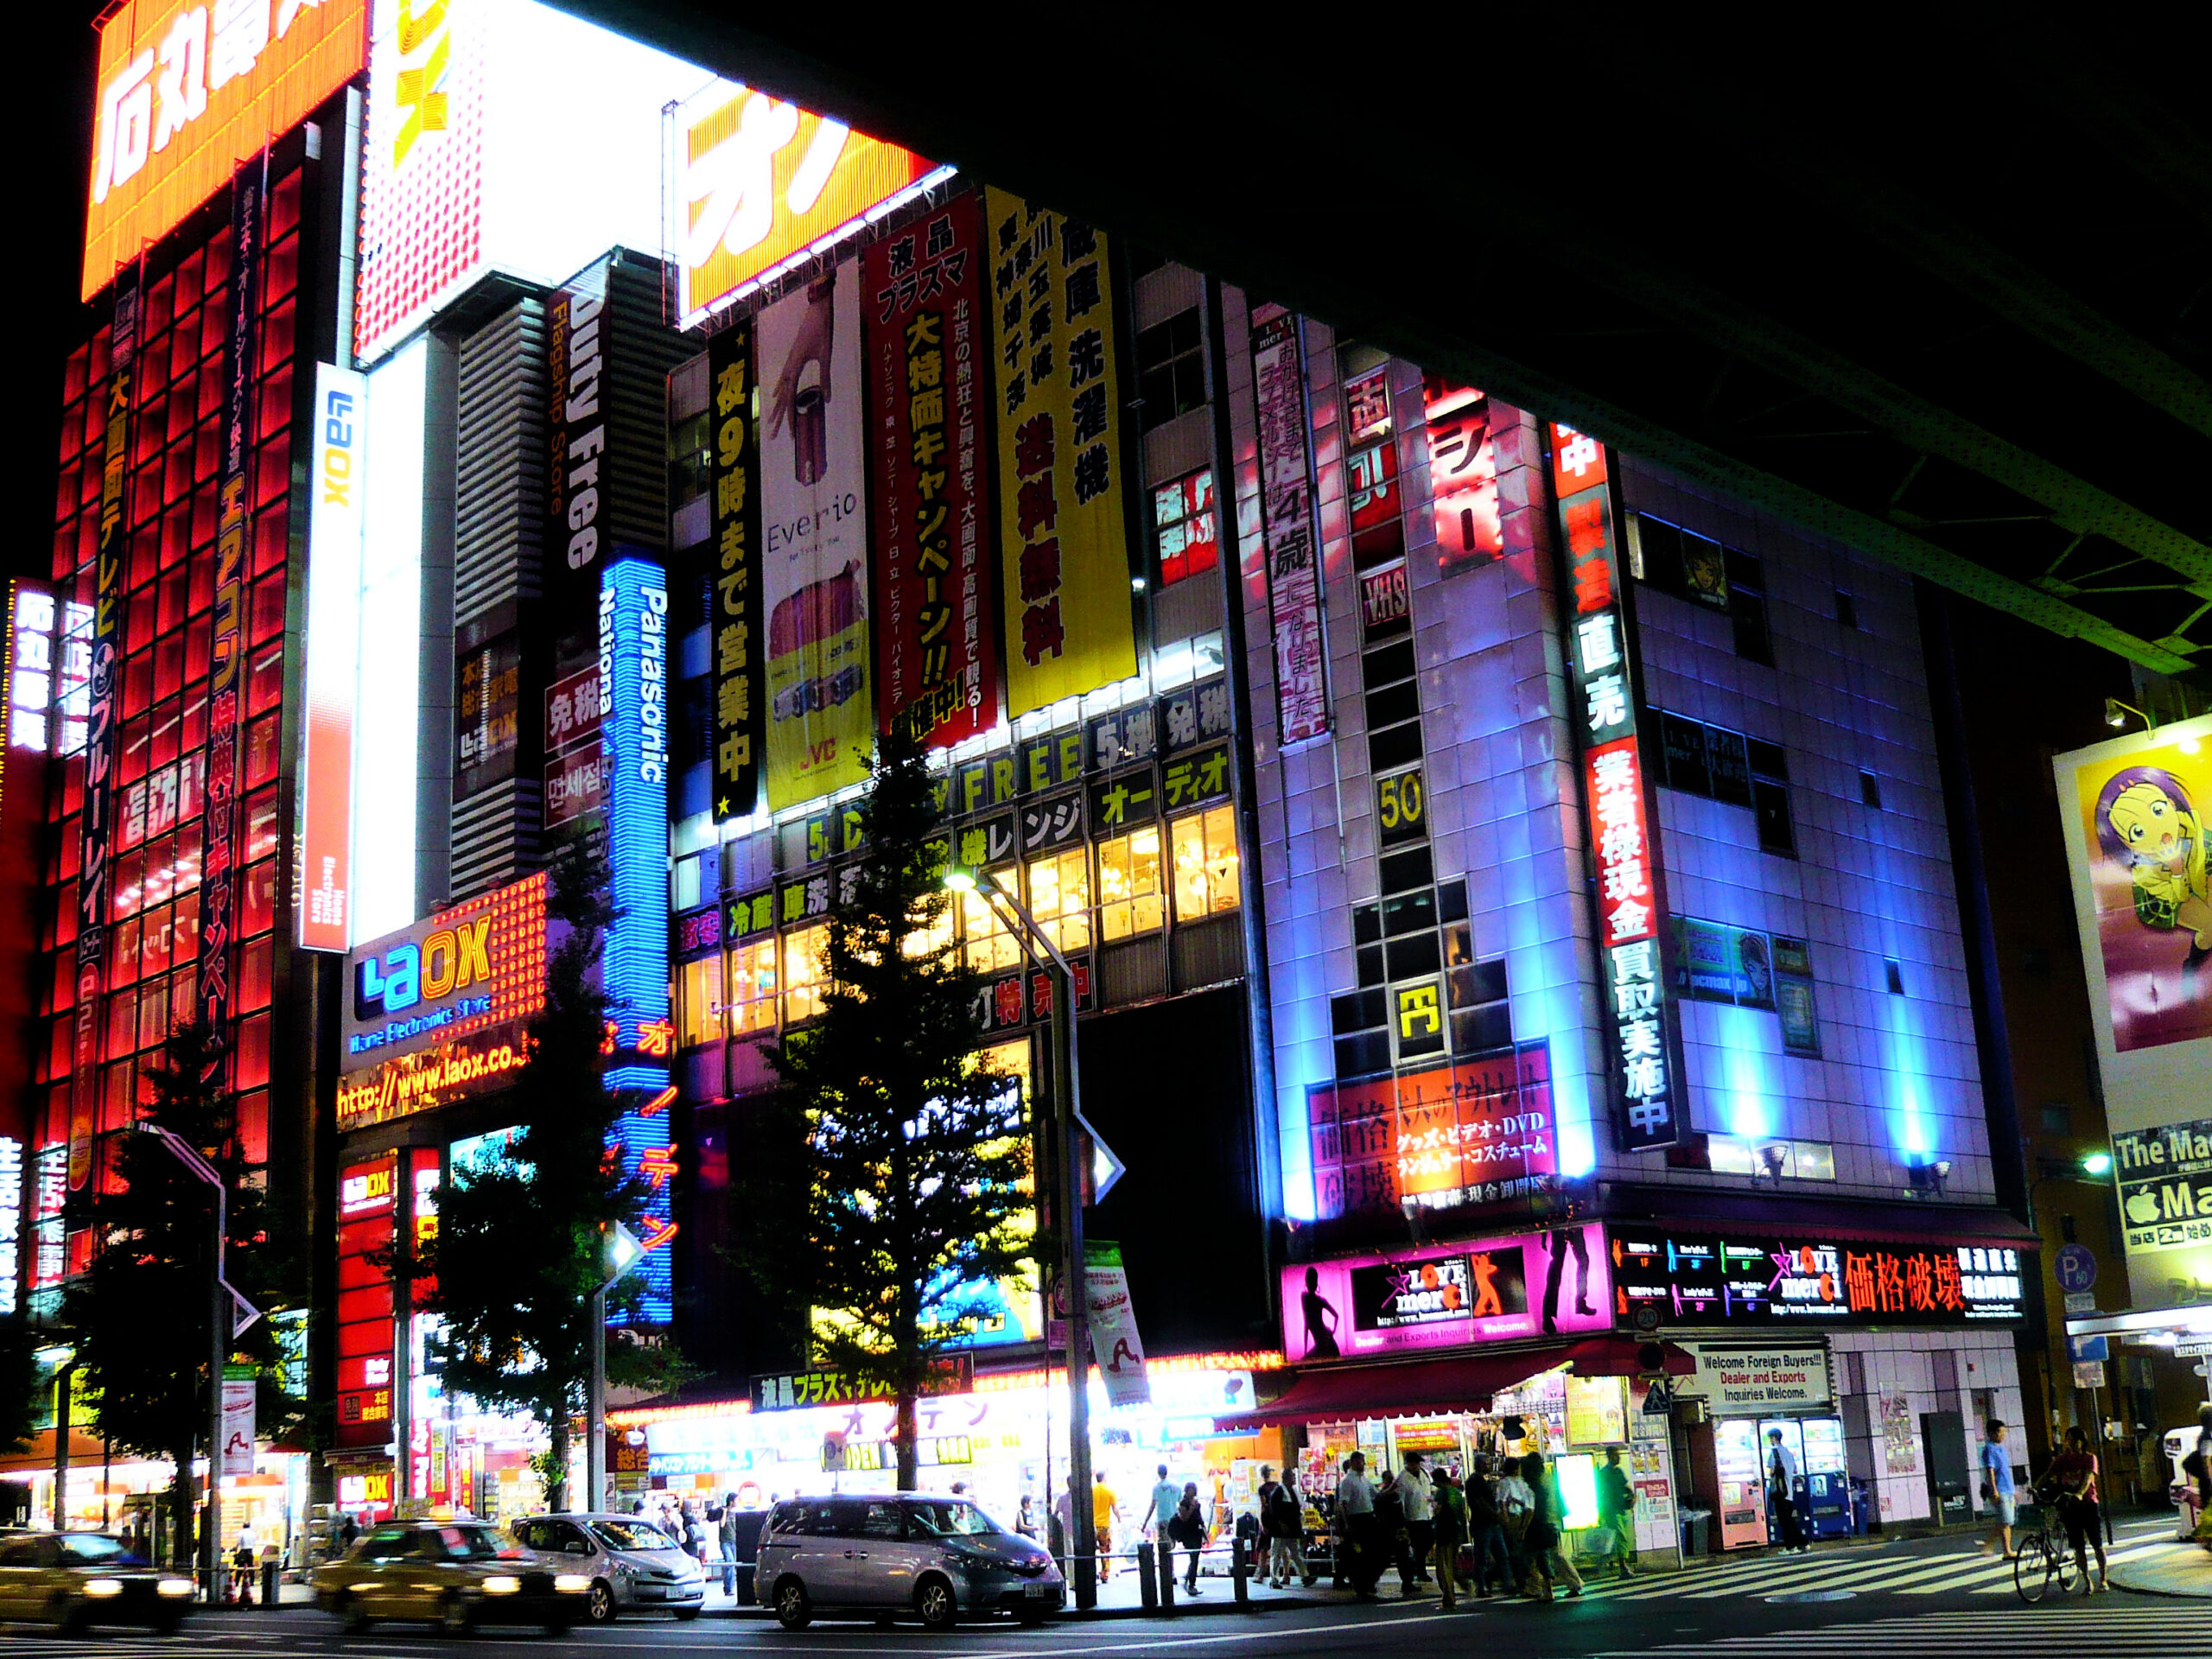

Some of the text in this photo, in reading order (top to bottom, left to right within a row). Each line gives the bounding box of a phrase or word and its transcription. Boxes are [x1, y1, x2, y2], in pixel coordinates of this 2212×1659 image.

[878, 248, 968, 326] プラズマ
[550, 300, 567, 517] Flagship Store
[568, 423, 605, 570] Free
[767, 493, 858, 554] Everio
[716, 359, 751, 783] 夜9時まで営業中
[889, 545, 900, 581] 日立
[1365, 570, 1407, 623] VHS
[549, 680, 601, 737] 免税
[639, 586, 670, 785] Panasonic
[1166, 685, 1228, 747] 免税
[798, 737, 837, 771] JVC
[964, 734, 1081, 813] FREE
[1102, 751, 1229, 823] オーディオ
[1380, 773, 1422, 829] 50
[989, 796, 1082, 861] レンジ
[728, 883, 805, 939] 冷蔵庫
[2116, 1135, 2165, 1169] The
[1408, 1262, 1467, 1290] LOVE
[1780, 1272, 1842, 1302] merci
[1789, 1245, 1840, 1274] LOVE
[1845, 1249, 1965, 1313] 価格破壊
[2062, 1256, 2080, 1286] P
[1395, 1281, 1470, 1313] merci
[1703, 1355, 1745, 1370] Welcome
[1746, 1354, 1782, 1369] Foreign
[1719, 1370, 1806, 1384] Dealer and Exports
[1724, 1387, 1808, 1403] Inquiries Welcome.
